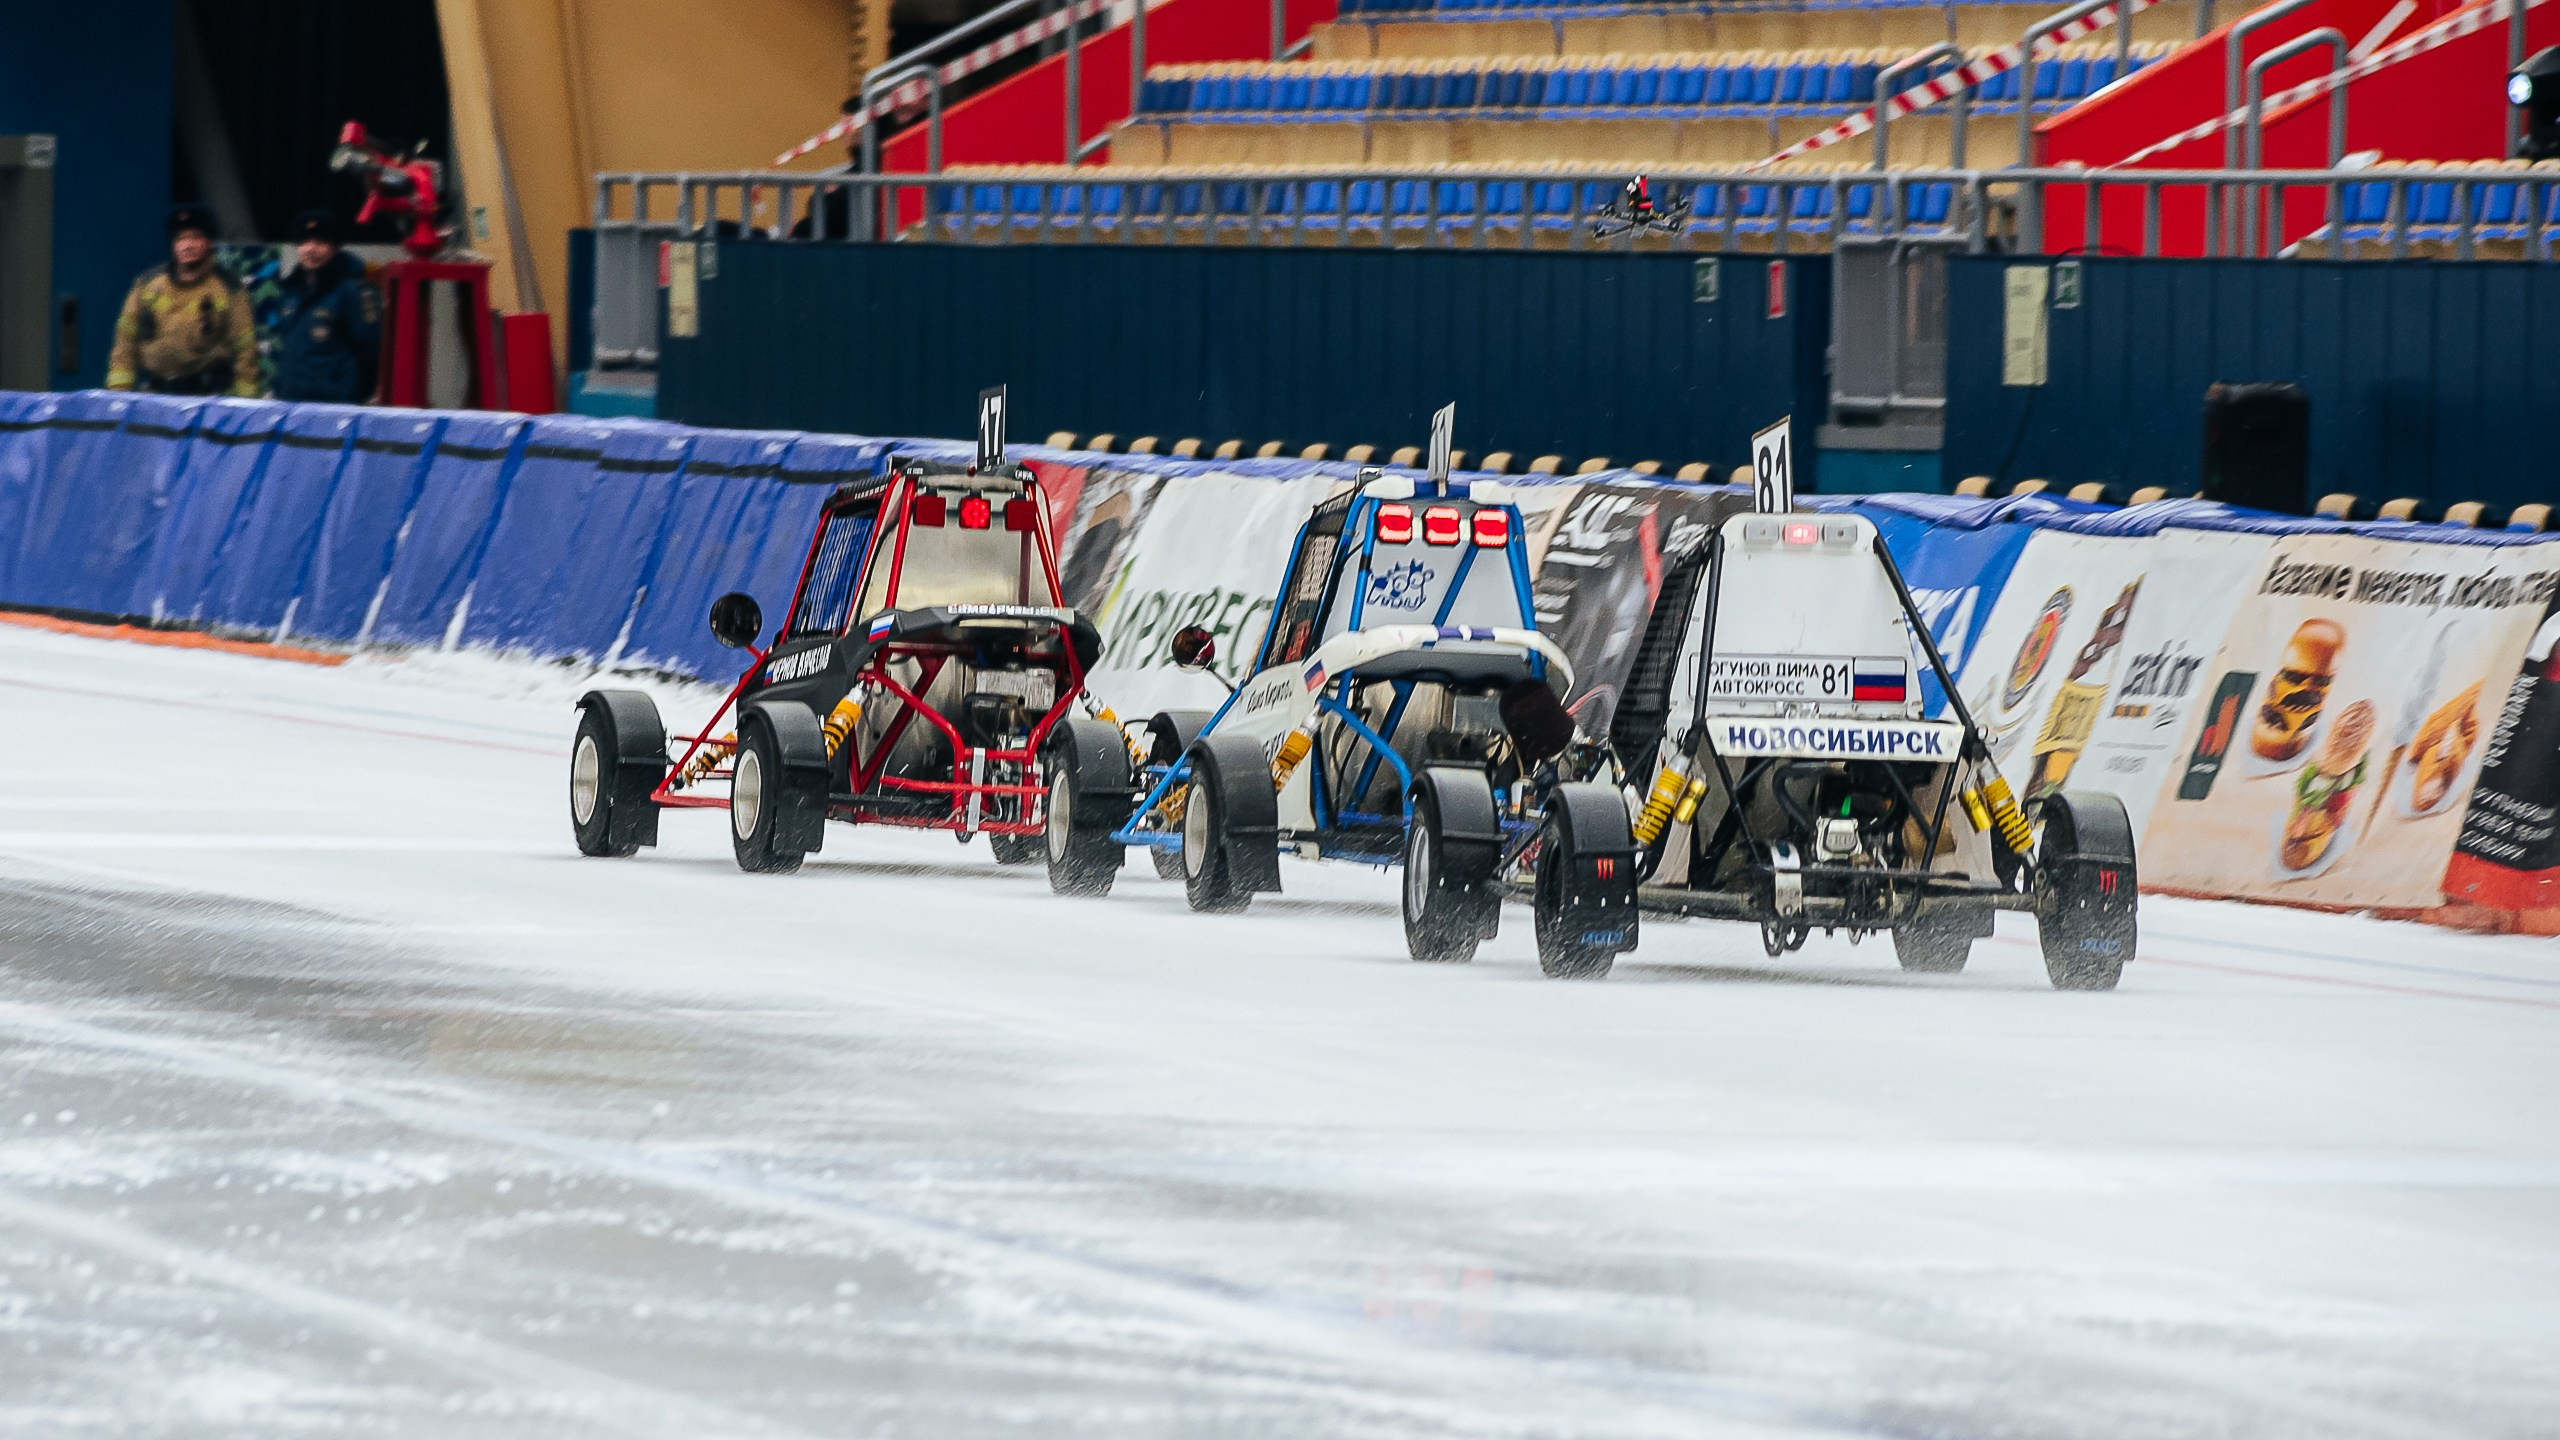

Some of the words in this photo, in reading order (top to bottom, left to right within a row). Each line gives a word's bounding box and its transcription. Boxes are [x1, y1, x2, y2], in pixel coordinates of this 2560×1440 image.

[980, 395, 1002, 459] 17
[1758, 434, 1788, 513] 81
[1710, 661, 1770, 677] ОГУНОВ
[1775, 662, 1819, 679] ДИМА
[1821, 663, 1849, 697] 81
[1712, 680, 1805, 696] АВТОКРОСС
[1728, 726, 1943, 755] НОВОСИБИРСК
